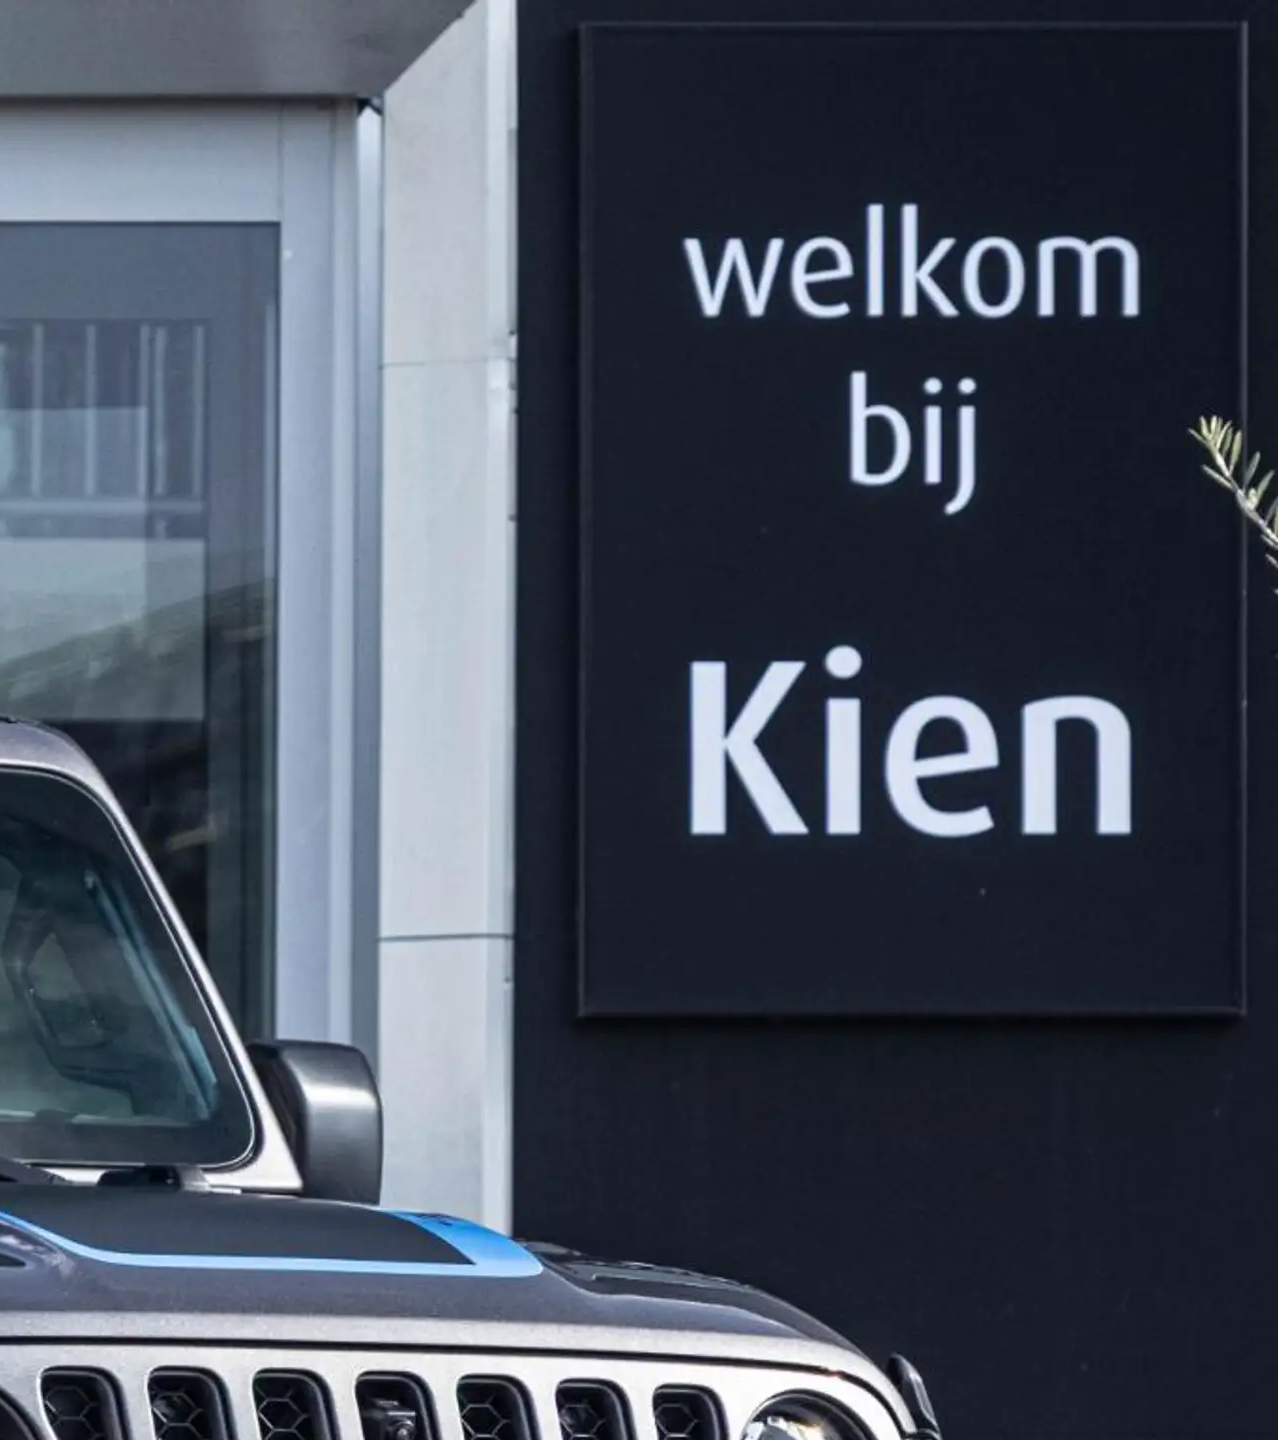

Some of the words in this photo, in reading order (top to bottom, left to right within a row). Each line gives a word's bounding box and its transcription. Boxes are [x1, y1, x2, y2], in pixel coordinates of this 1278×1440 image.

[683, 203, 1140, 319] welkom
[850, 371, 977, 515] bij
[690, 645, 1133, 838] Kien
